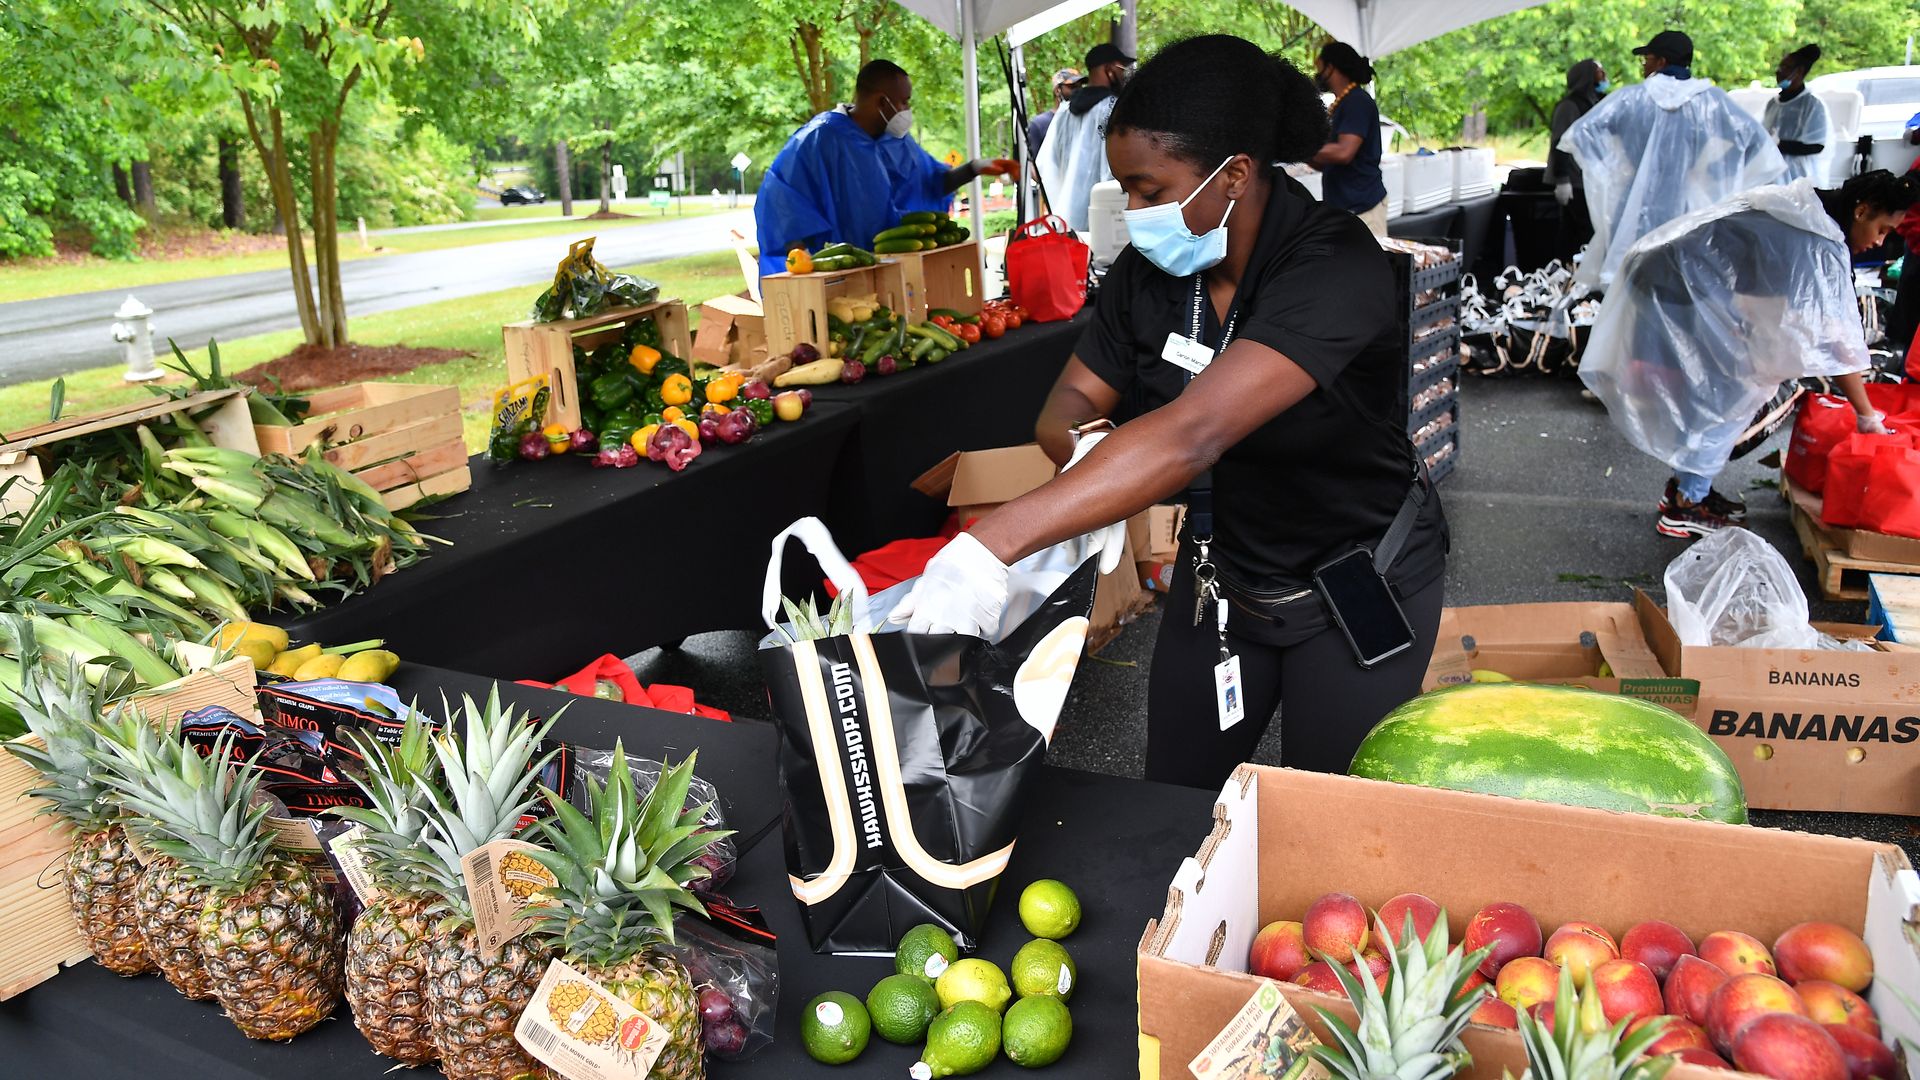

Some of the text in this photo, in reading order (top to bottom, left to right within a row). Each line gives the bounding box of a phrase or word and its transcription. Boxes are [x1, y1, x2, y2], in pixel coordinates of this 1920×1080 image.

[1189, 296, 1203, 340] livehealthy
[1768, 671, 1861, 687] BANANAS
[1623, 683, 1684, 694] Premium
[276, 697, 315, 711] PREMIUM GRAPES
[1708, 710, 1920, 744] BANANAS
[830, 662, 884, 849] HAWKSSHOP.COM
[569, 1047, 585, 1061] MONTE
